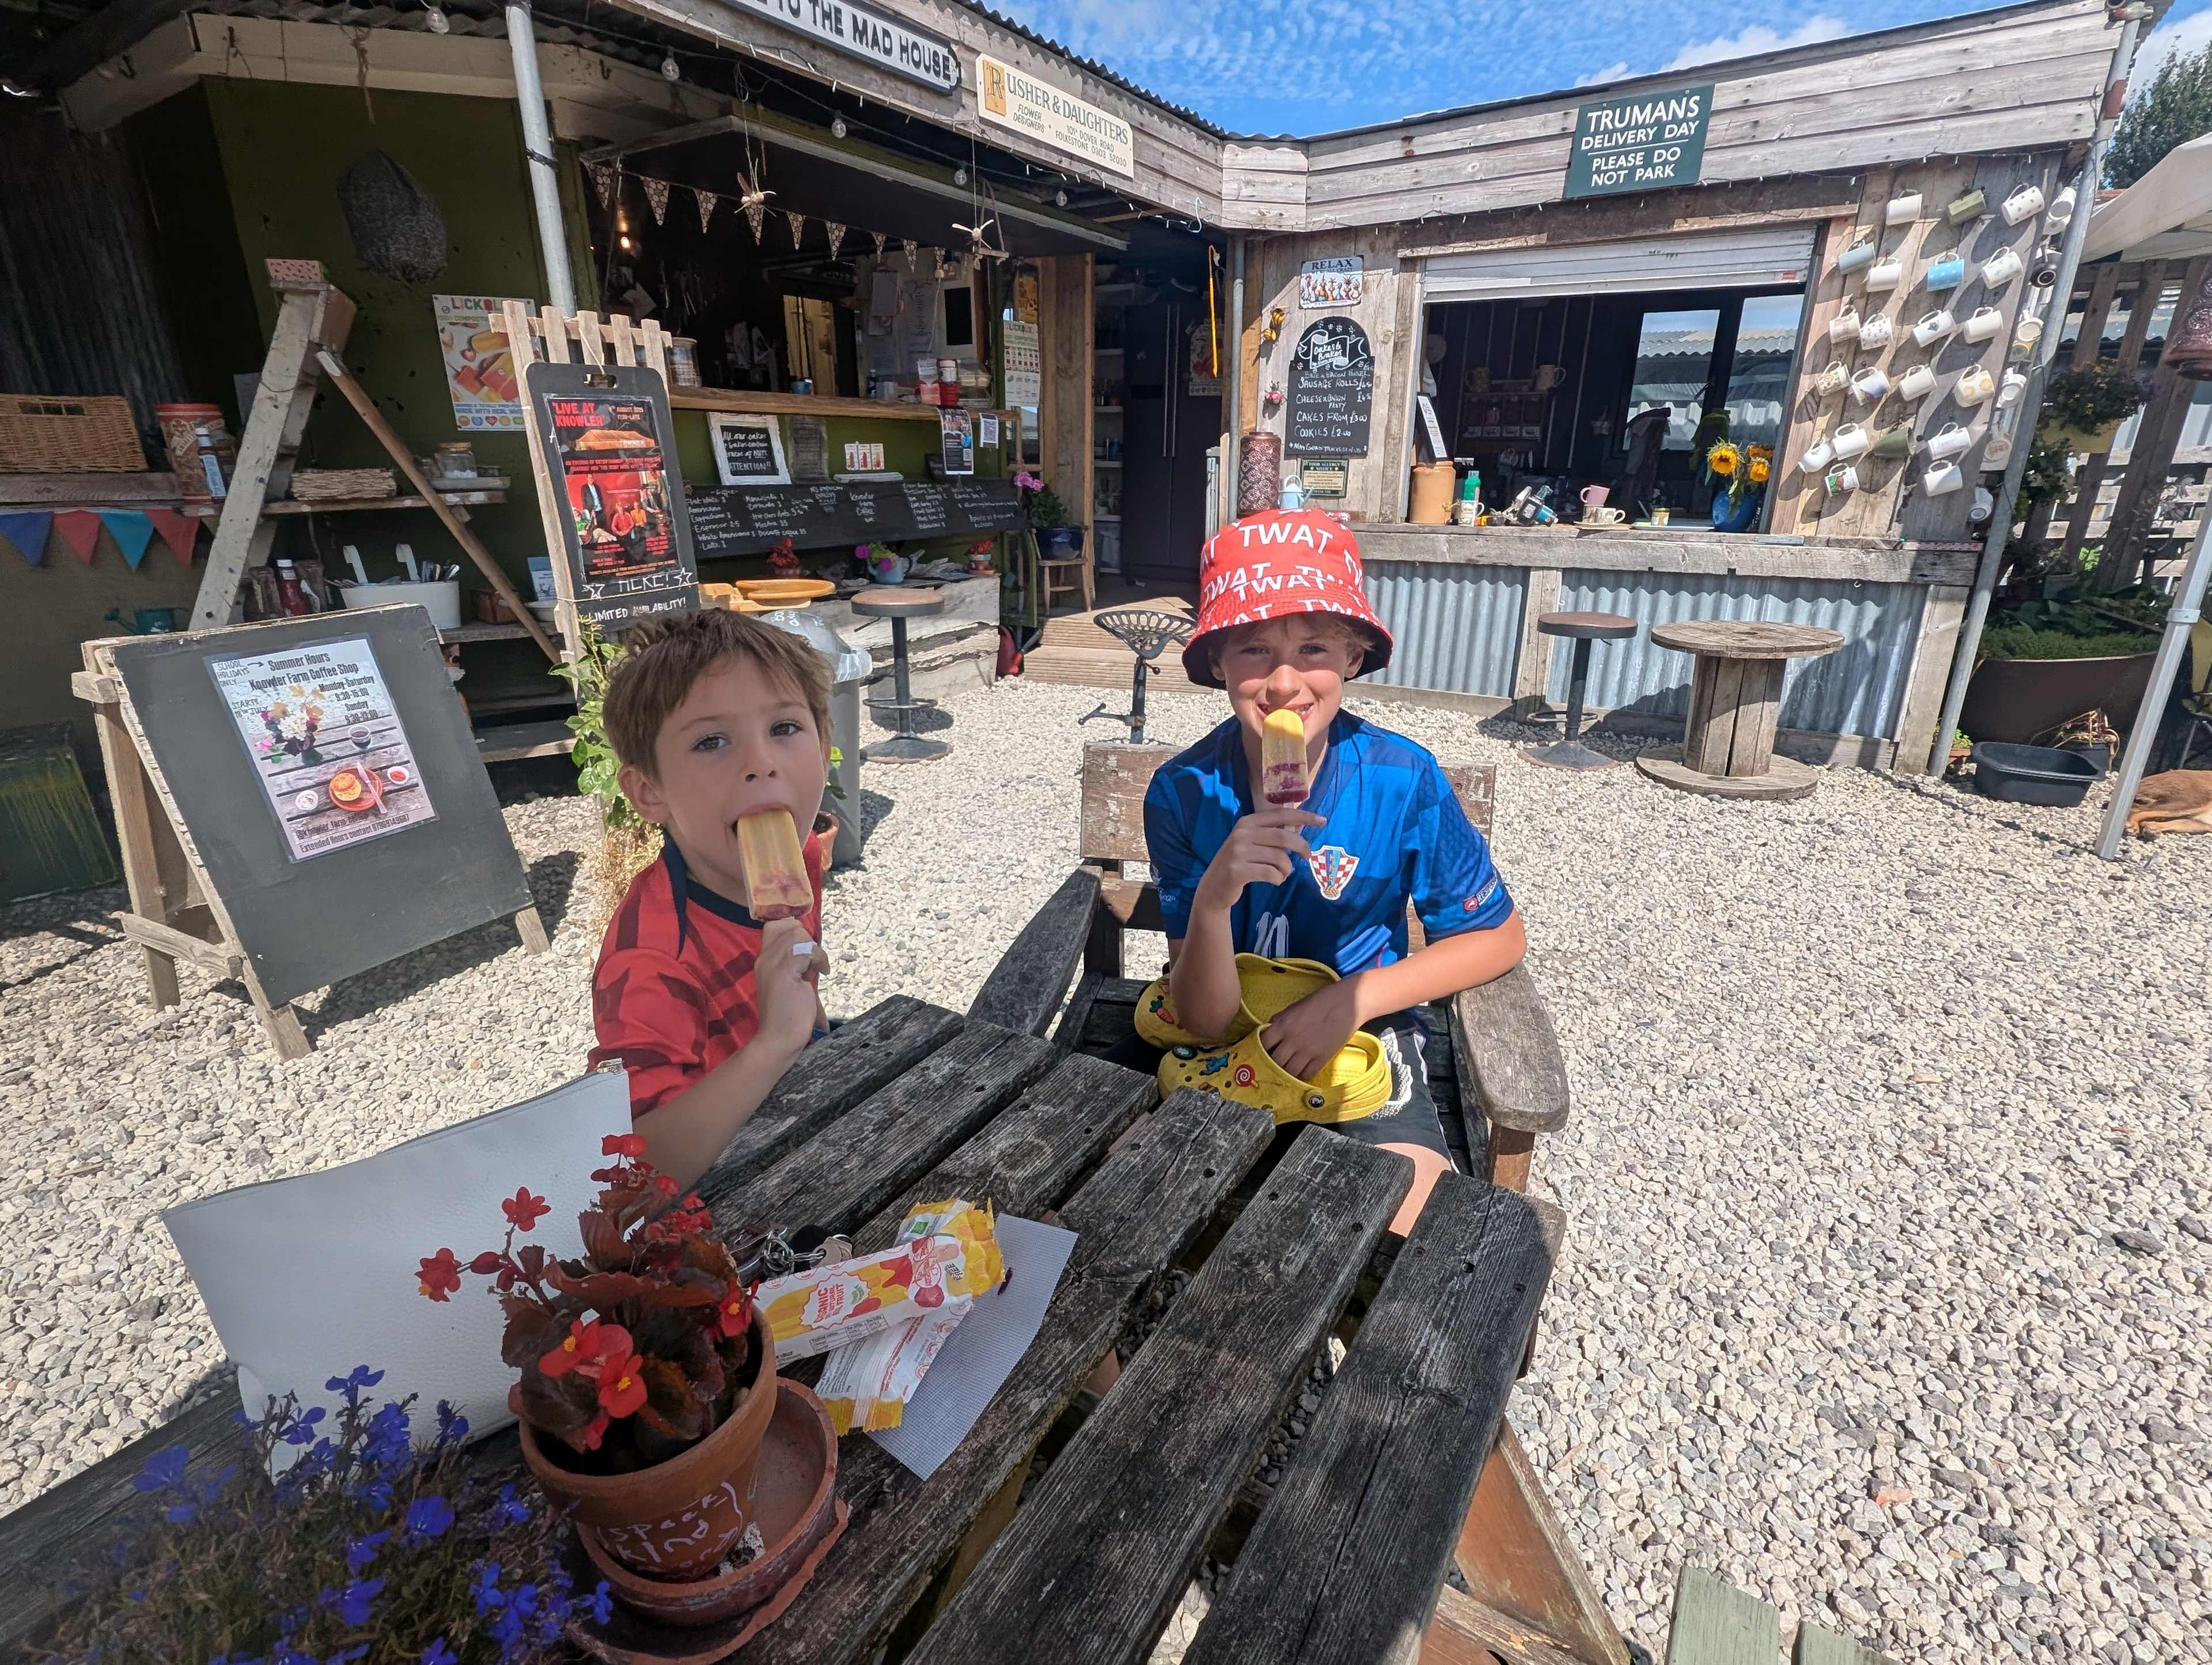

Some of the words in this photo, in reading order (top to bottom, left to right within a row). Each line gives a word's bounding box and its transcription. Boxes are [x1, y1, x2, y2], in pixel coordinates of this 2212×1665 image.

[809, 1, 844, 38] THE
[852, 13, 894, 57] MAD
[899, 33, 952, 82] HOUSE
[1013, 112, 1046, 134] DESIGNERS
[1017, 104, 1042, 123] FLOWER
[1052, 94, 1061, 115] &
[1062, 98, 1128, 145] DAUGHTERS
[1587, 95, 1700, 133] TRUMANS
[1080, 130, 1099, 146] DOVER
[1100, 137, 1115, 153] ROAD
[1581, 126, 1658, 151] DELIVERY
[1664, 120, 1700, 139] DAY
[1055, 130, 1089, 152] FOLKESTONE
[1092, 146, 1107, 160] 0303
[1109, 153, 1127, 168] 52030
[1592, 151, 1645, 172] PLEASE
[1653, 146, 1681, 164] DO
[1591, 169, 1629, 187] NOT
[1635, 164, 1676, 181] PARK
[1311, 259, 1354, 271] RELAX
[1298, 377, 1332, 390] SAUSAGE
[1335, 379, 1358, 388] ROLLS
[582, 403, 596, 414] AT
[1328, 402, 1347, 412] PASTY
[1296, 411, 1324, 423] CAKES
[1326, 412, 1349, 426] FROM
[1294, 425, 1328, 438] COOKIES
[1238, 522, 1334, 555] TWAT
[1232, 574, 1327, 602] TWAT
[588, 608, 628, 622] LIMITED
[217, 661, 244, 671] SCHOOL
[268, 656, 305, 672] Summer
[304, 653, 331, 666] Hours
[216, 667, 251, 679] HOLIDAYS
[248, 674, 287, 691] Knowler
[288, 671, 310, 686] Farm
[310, 665, 338, 680] Coffee
[338, 662, 360, 675] Shop
[219, 678, 238, 688] ONLY
[232, 699, 259, 710] STARTS
[249, 706, 269, 715] JULY
[345, 700, 369, 712] Sunday
[299, 838, 331, 854] Extended
[349, 826, 373, 839] contact
[835, 1283, 845, 1306] FRUIT
